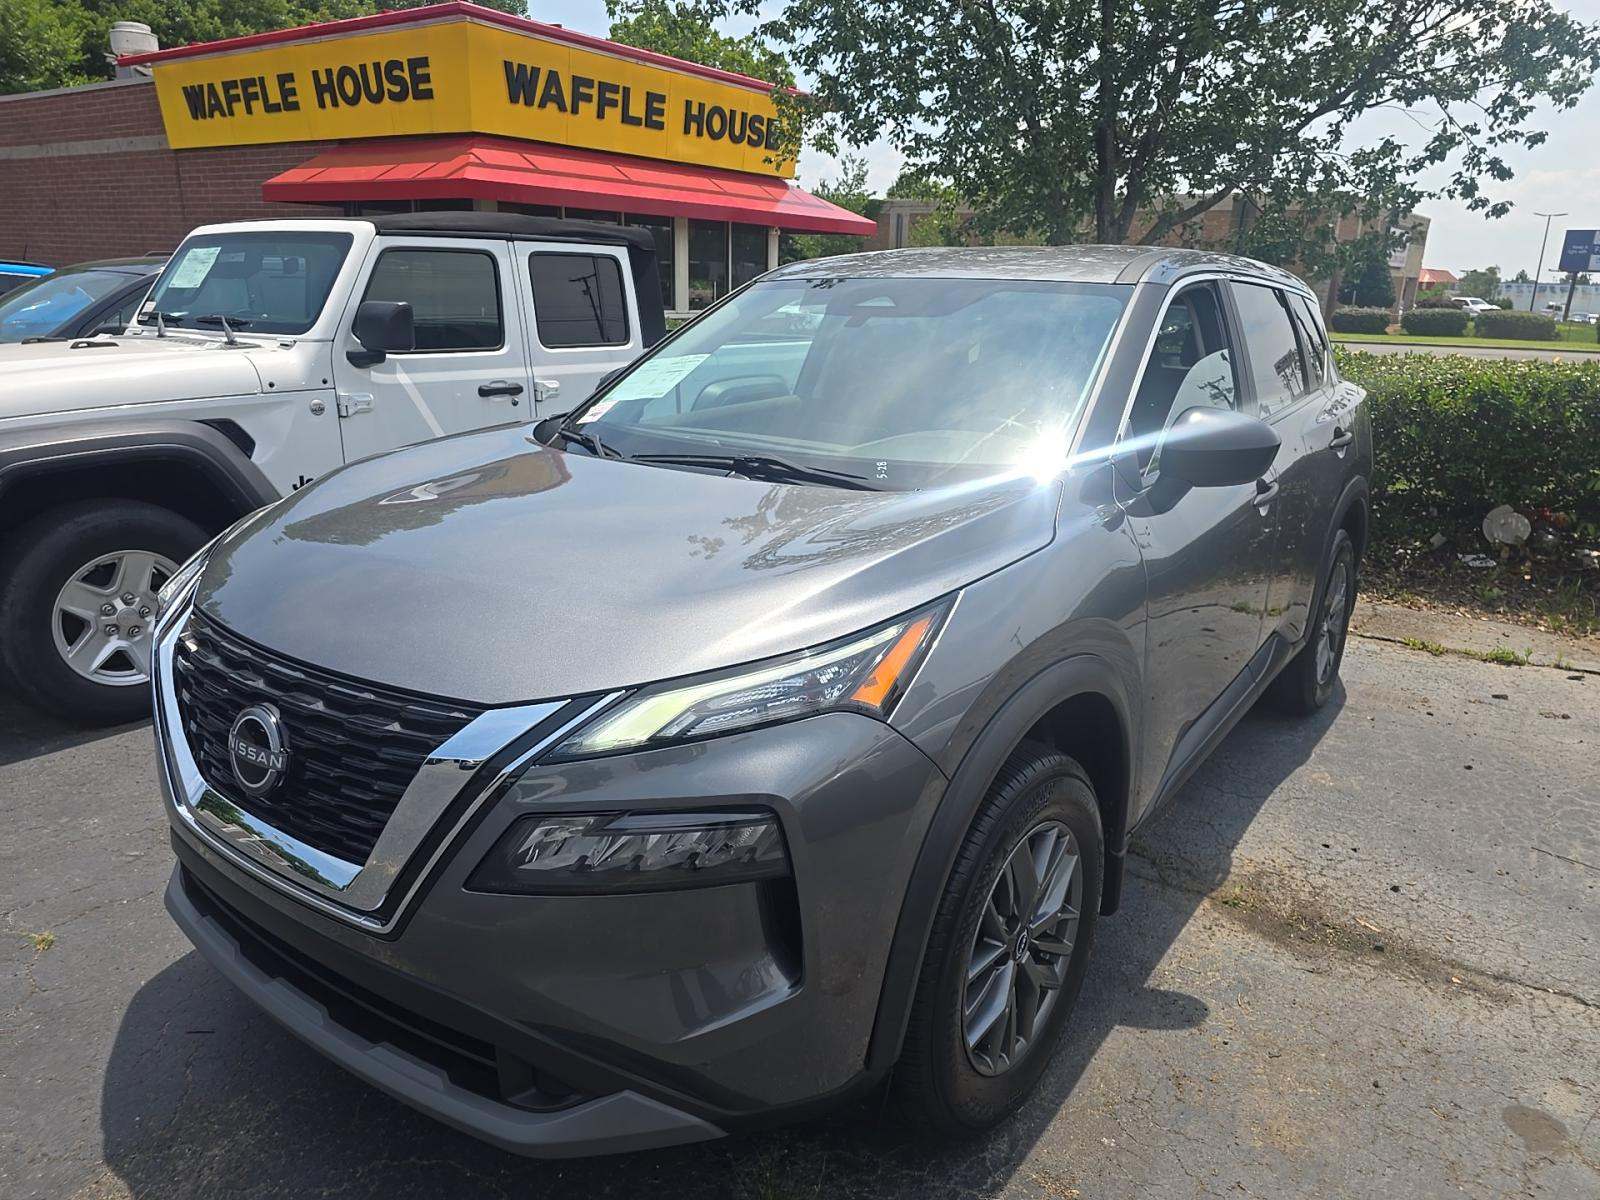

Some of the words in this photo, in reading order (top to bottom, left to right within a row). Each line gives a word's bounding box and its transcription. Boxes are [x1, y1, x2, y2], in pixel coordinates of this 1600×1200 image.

[182, 72, 300, 121] WAFFLE
[312, 56, 434, 110] HOUSE
[503, 59, 666, 131] WAFFLE
[683, 98, 781, 151] HOUSE
[227, 734, 283, 769] NISSAN
